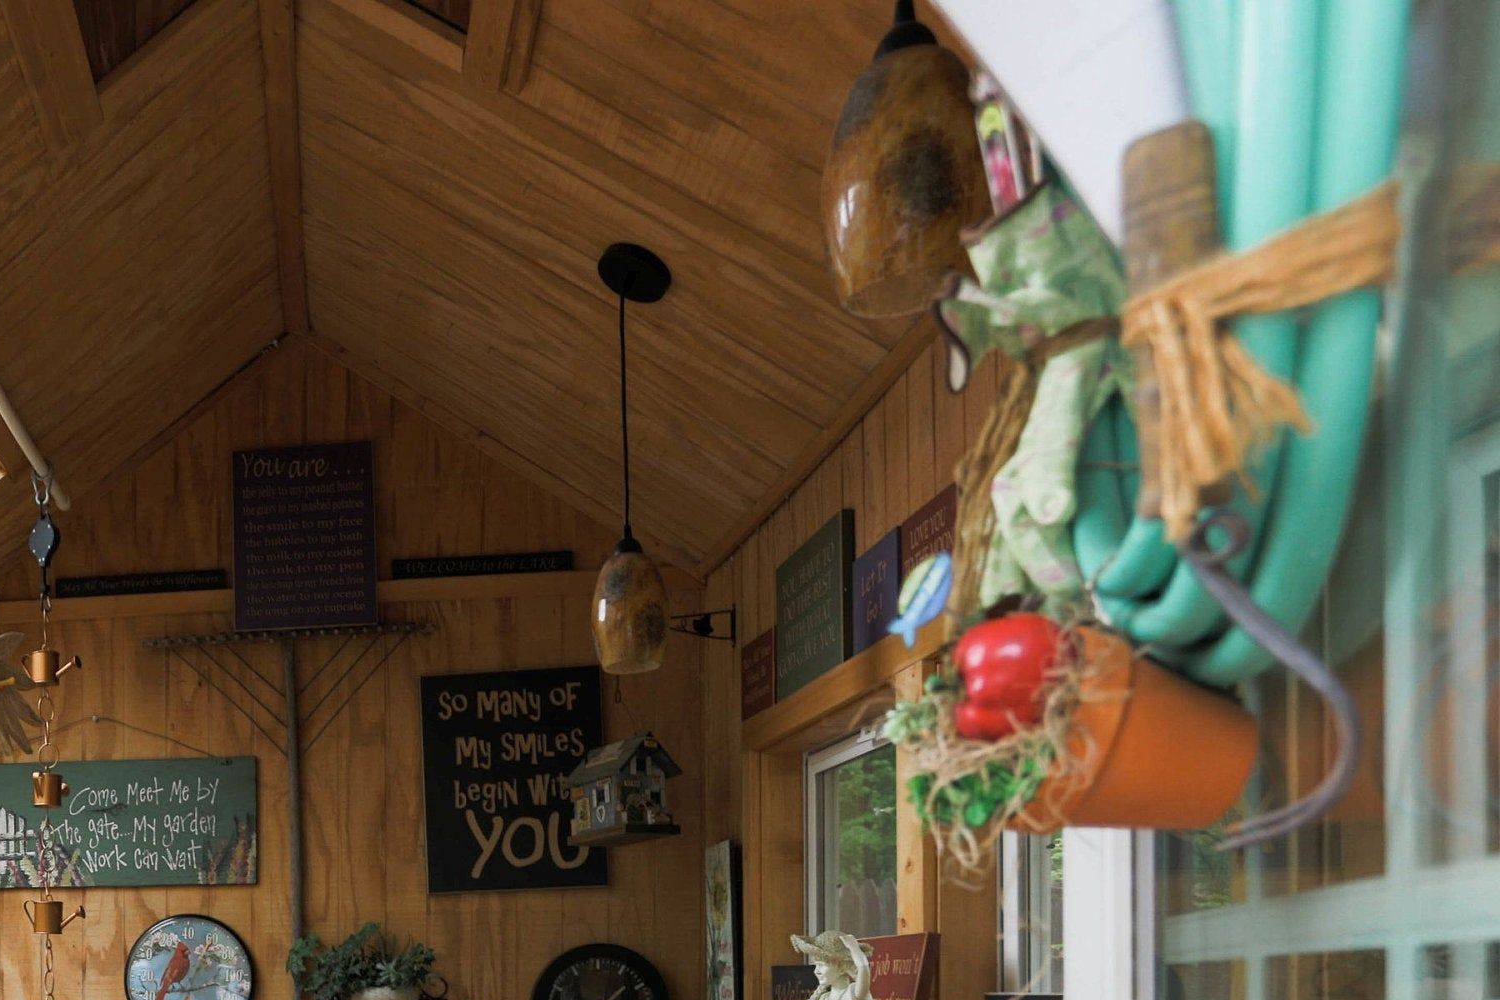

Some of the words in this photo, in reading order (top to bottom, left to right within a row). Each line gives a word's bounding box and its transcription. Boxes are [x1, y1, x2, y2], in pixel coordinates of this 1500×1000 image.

[242, 453, 283, 479] You
[245, 520, 264, 532] the
[266, 518, 299, 531] smile
[301, 519, 314, 529] to
[317, 519, 335, 531] my
[338, 516, 363, 527] face
[245, 535, 262, 547] the
[307, 534, 319, 546] to
[320, 534, 337, 547] my
[338, 531, 363, 542] bath
[246, 551, 264, 563] the
[266, 549, 292, 562] milk
[294, 550, 305, 560] to
[307, 549, 326, 562] my
[327, 546, 364, 557] cookie
[247, 565, 268, 575] the
[271, 563, 294, 575] ink
[297, 563, 311, 573] to
[314, 563, 336, 576] my
[339, 562, 364, 573] pen
[247, 593, 266, 604] the
[267, 592, 296, 604] water
[299, 592, 311, 601] to
[313, 592, 330, 604] my
[332, 589, 365, 601] ocean
[246, 606, 263, 617] the
[69, 785, 118, 815] Come
[127, 776, 164, 805] Meet
[169, 779, 190, 803] Me
[527, 772, 572, 806] Wit
[50, 818, 82, 846] The
[162, 806, 216, 840] garden
[182, 927, 195, 940] 40
[205, 933, 218, 946] 60
[872, 952, 891, 982] job
[893, 951, 919, 976] won't
